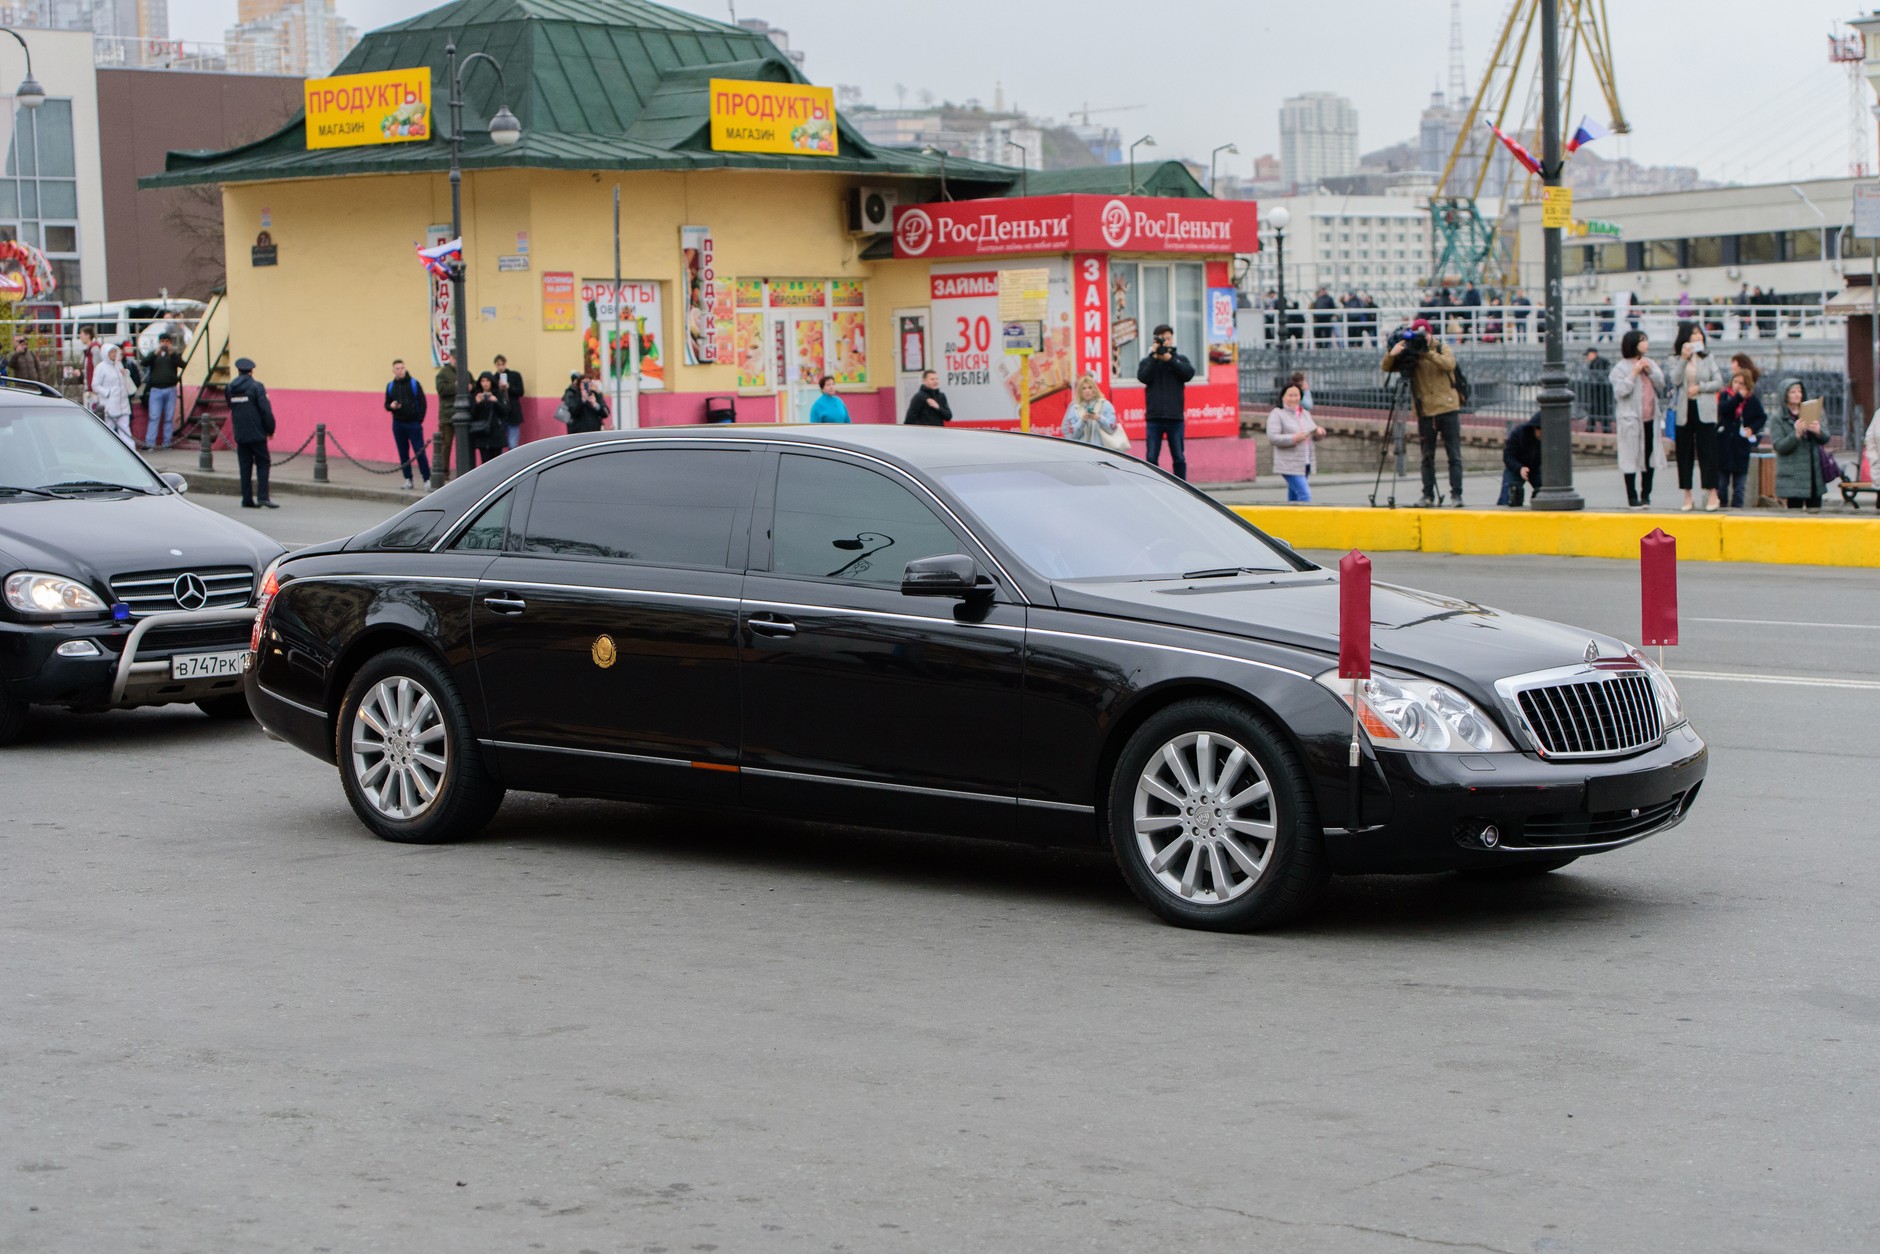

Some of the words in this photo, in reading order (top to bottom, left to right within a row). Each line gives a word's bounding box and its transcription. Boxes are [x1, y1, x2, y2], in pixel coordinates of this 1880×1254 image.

[309, 81, 422, 114] ПРОДУКТЫ
[716, 92, 829, 121] ПРОДУКТЫ
[319, 122, 365, 136] МАГАЗИН
[726, 128, 775, 140] МАГАЗИН
[937, 214, 1068, 243] РосДеньги
[1134, 211, 1231, 240] РосДеньги
[581, 284, 655, 302] ФРУКТЫ
[934, 277, 998, 296] ЗАЙМЫ
[703, 239, 717, 359] ПРОДУКТЫ
[774, 295, 818, 305] ПРОДУКТЫ
[957, 315, 991, 353] 30
[945, 353, 990, 371] ТЫСЯЧ
[947, 370, 990, 386] РУБЛЕЙ
[180, 656, 237, 676] В747РК
